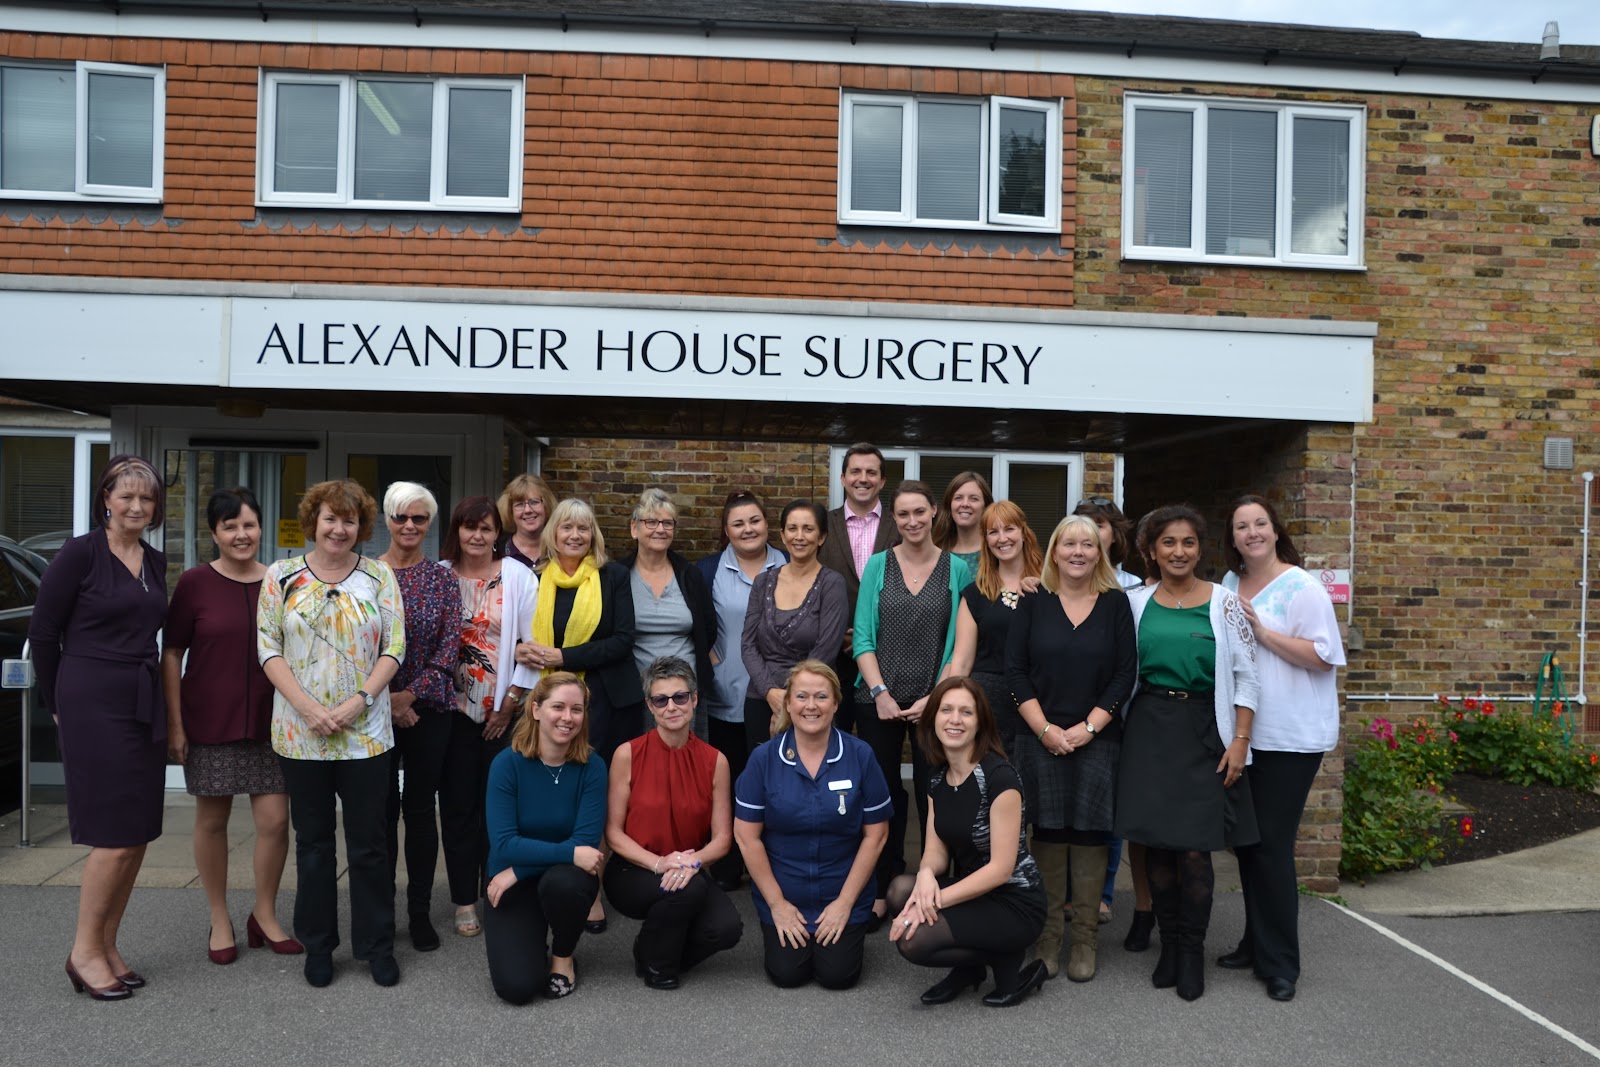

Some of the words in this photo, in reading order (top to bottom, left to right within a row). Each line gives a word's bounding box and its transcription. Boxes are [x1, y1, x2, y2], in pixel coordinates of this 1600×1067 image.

[257, 322, 569, 371] ALEXANDER
[597, 329, 782, 377] HOUSE
[804, 336, 1043, 385] SURGERY
